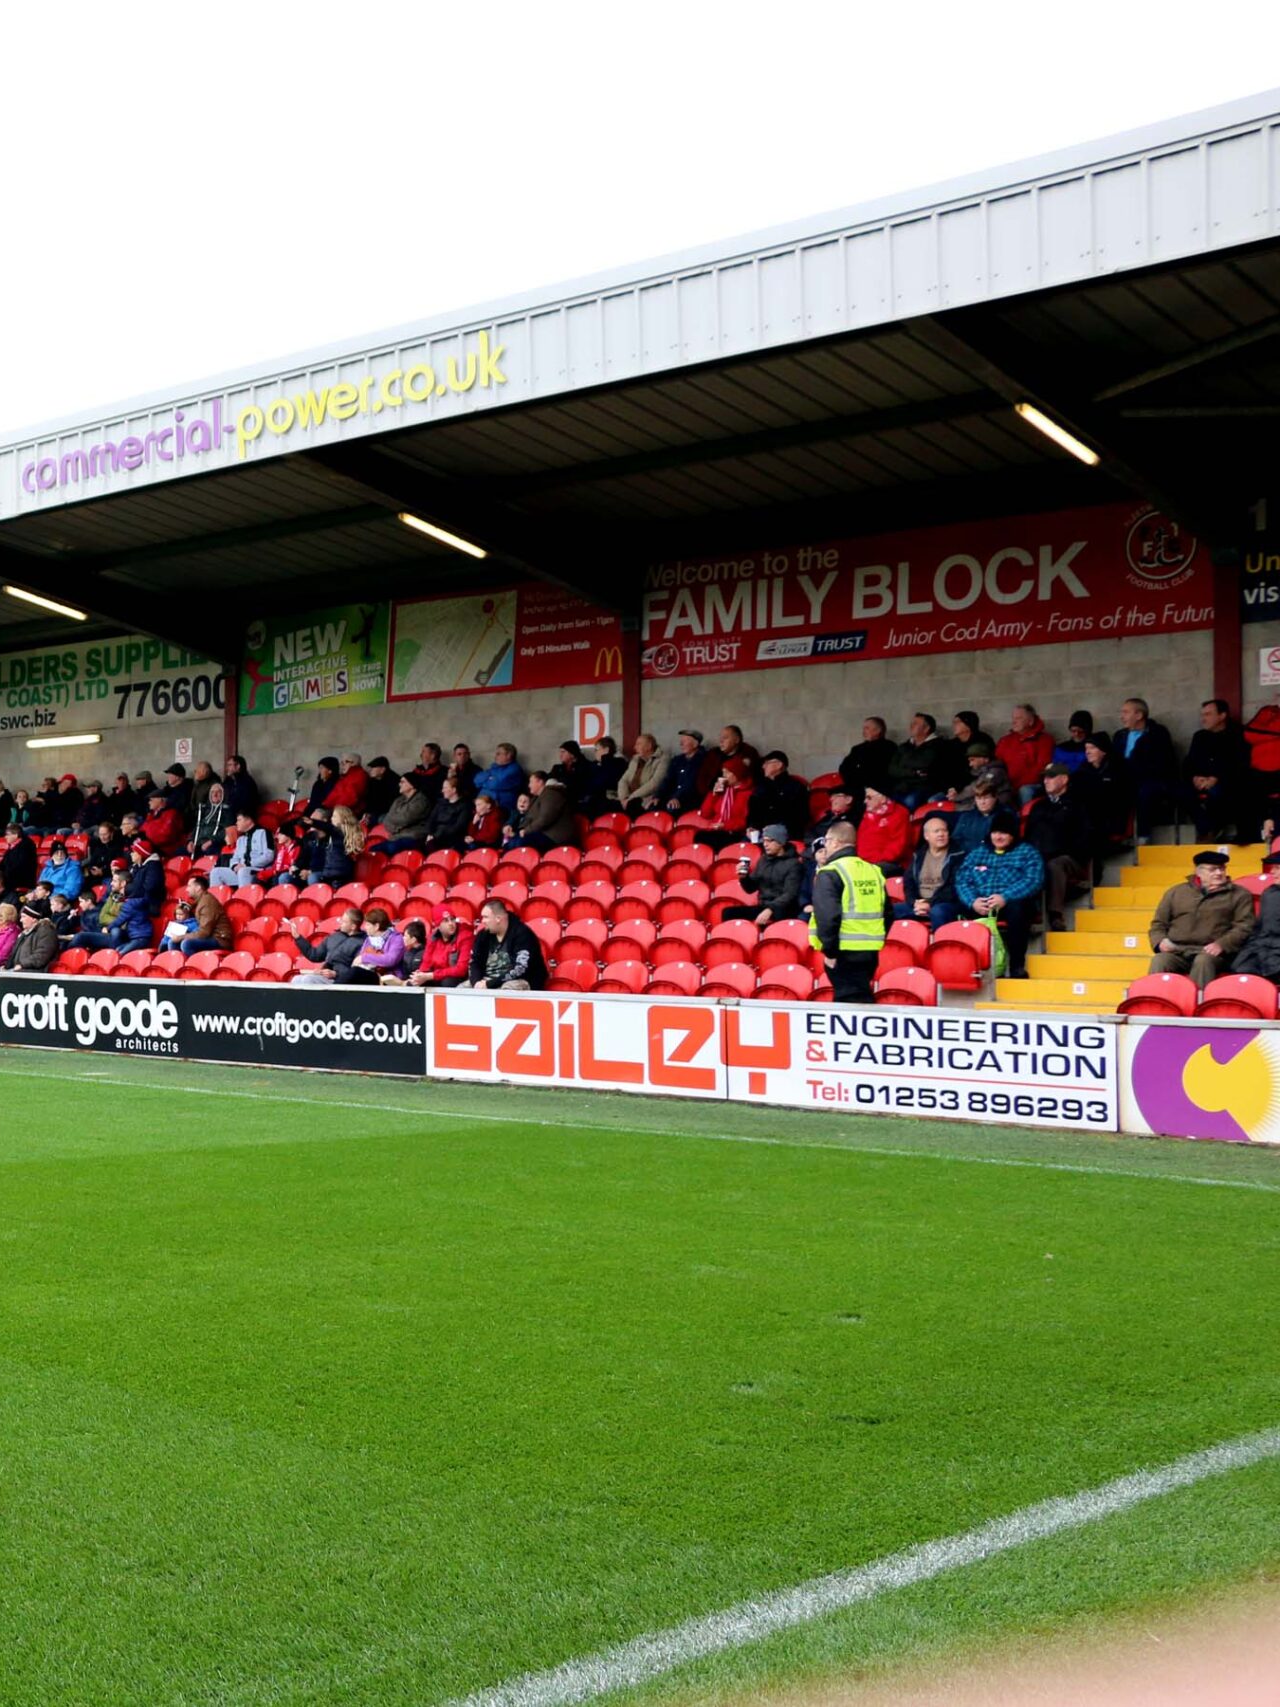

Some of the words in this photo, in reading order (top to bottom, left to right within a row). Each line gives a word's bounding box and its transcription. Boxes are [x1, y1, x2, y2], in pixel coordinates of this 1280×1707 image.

[22, 330, 507, 493] commercial-power.co.uk
[644, 559, 755, 590] Welcome
[763, 551, 789, 575] to
[798, 546, 840, 570] the
[641, 570, 840, 641] FAMILY
[851, 540, 1091, 620] BLOCK
[273, 619, 348, 667] NEW
[815, 636, 865, 652] TRUST
[884, 629, 938, 650] Junior
[940, 619, 979, 643] Cod
[981, 616, 1033, 642] Army
[1047, 609, 1094, 632] Fans
[1099, 606, 1123, 630] of
[1124, 605, 1156, 629] the
[86, 640, 208, 679] SUPPLIE
[273, 655, 349, 683] INTERACTIVE
[682, 643, 742, 666] TRUST
[7, 684, 70, 708] COAST)
[75, 679, 108, 701] LTD
[275, 670, 348, 708] GAMES
[579, 707, 606, 745] D
[0, 984, 68, 1031] croft
[74, 988, 179, 1045] goode
[191, 1012, 422, 1045] www.croftgoode.co.uk
[805, 1012, 1106, 1050] ENGINEERING
[115, 1036, 179, 1054] architects
[805, 1040, 827, 1062] &
[832, 1040, 1108, 1080] FABRICATION
[806, 1079, 850, 1103] Tel:
[855, 1083, 960, 1112] 01253
[966, 1090, 1110, 1124] 896293
